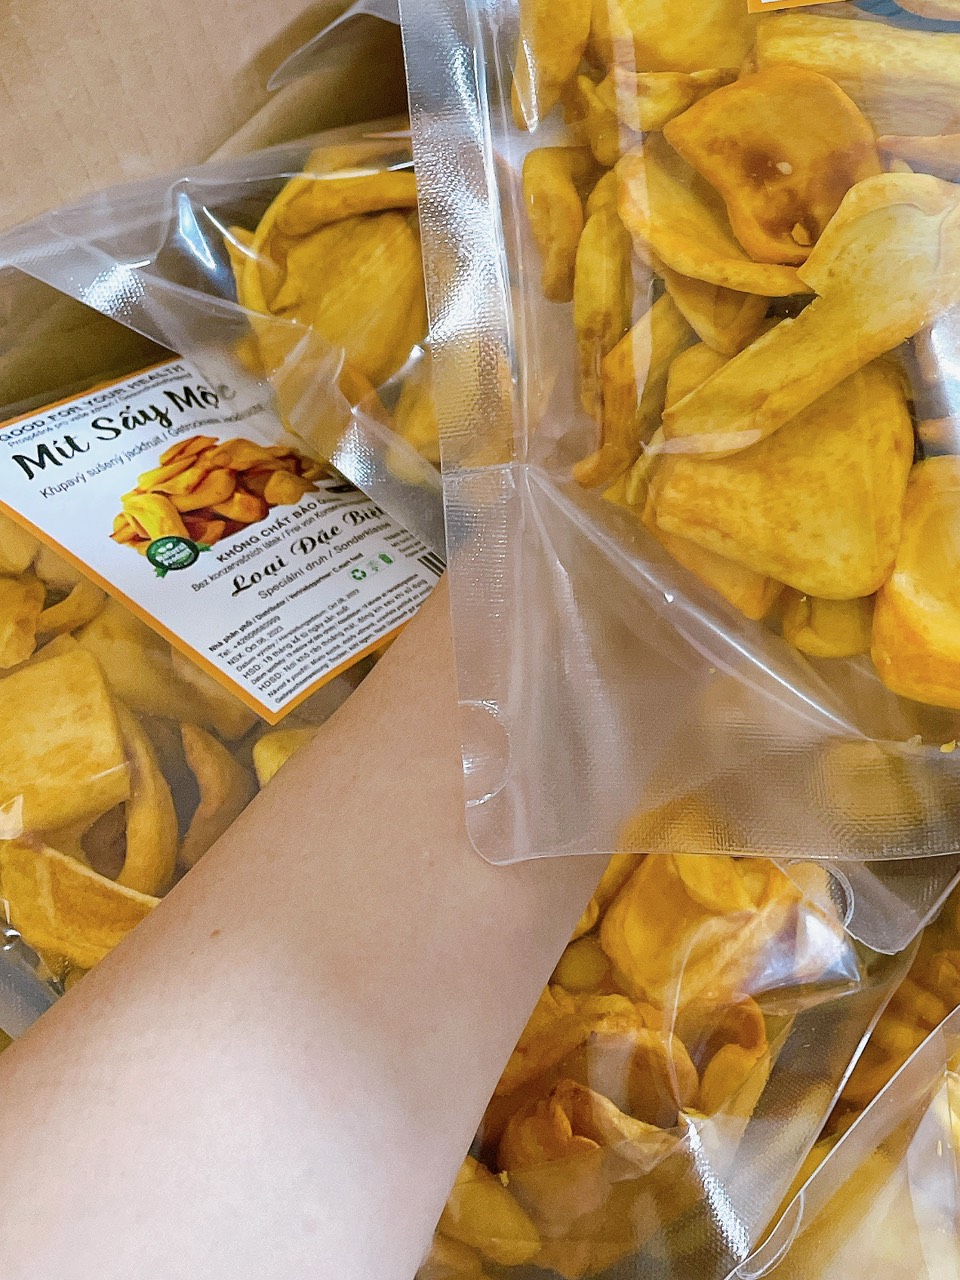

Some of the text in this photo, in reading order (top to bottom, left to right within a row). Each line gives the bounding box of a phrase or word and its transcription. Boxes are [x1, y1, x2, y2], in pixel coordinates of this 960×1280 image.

[48, 405, 84, 421] FOR
[84, 388, 127, 409] YOUR
[12, 435, 90, 480] Mít
[92, 402, 174, 441] Sấy
[40, 471, 87, 499] Křupavý
[216, 536, 260, 563] KHÔNG
[261, 517, 291, 537] CHẤT
[293, 502, 317, 519] BẢO
[231, 555, 290, 597] Loại
[290, 524, 344, 556] Đặc
[258, 567, 305, 600] Speciální
[305, 552, 329, 572] druh
